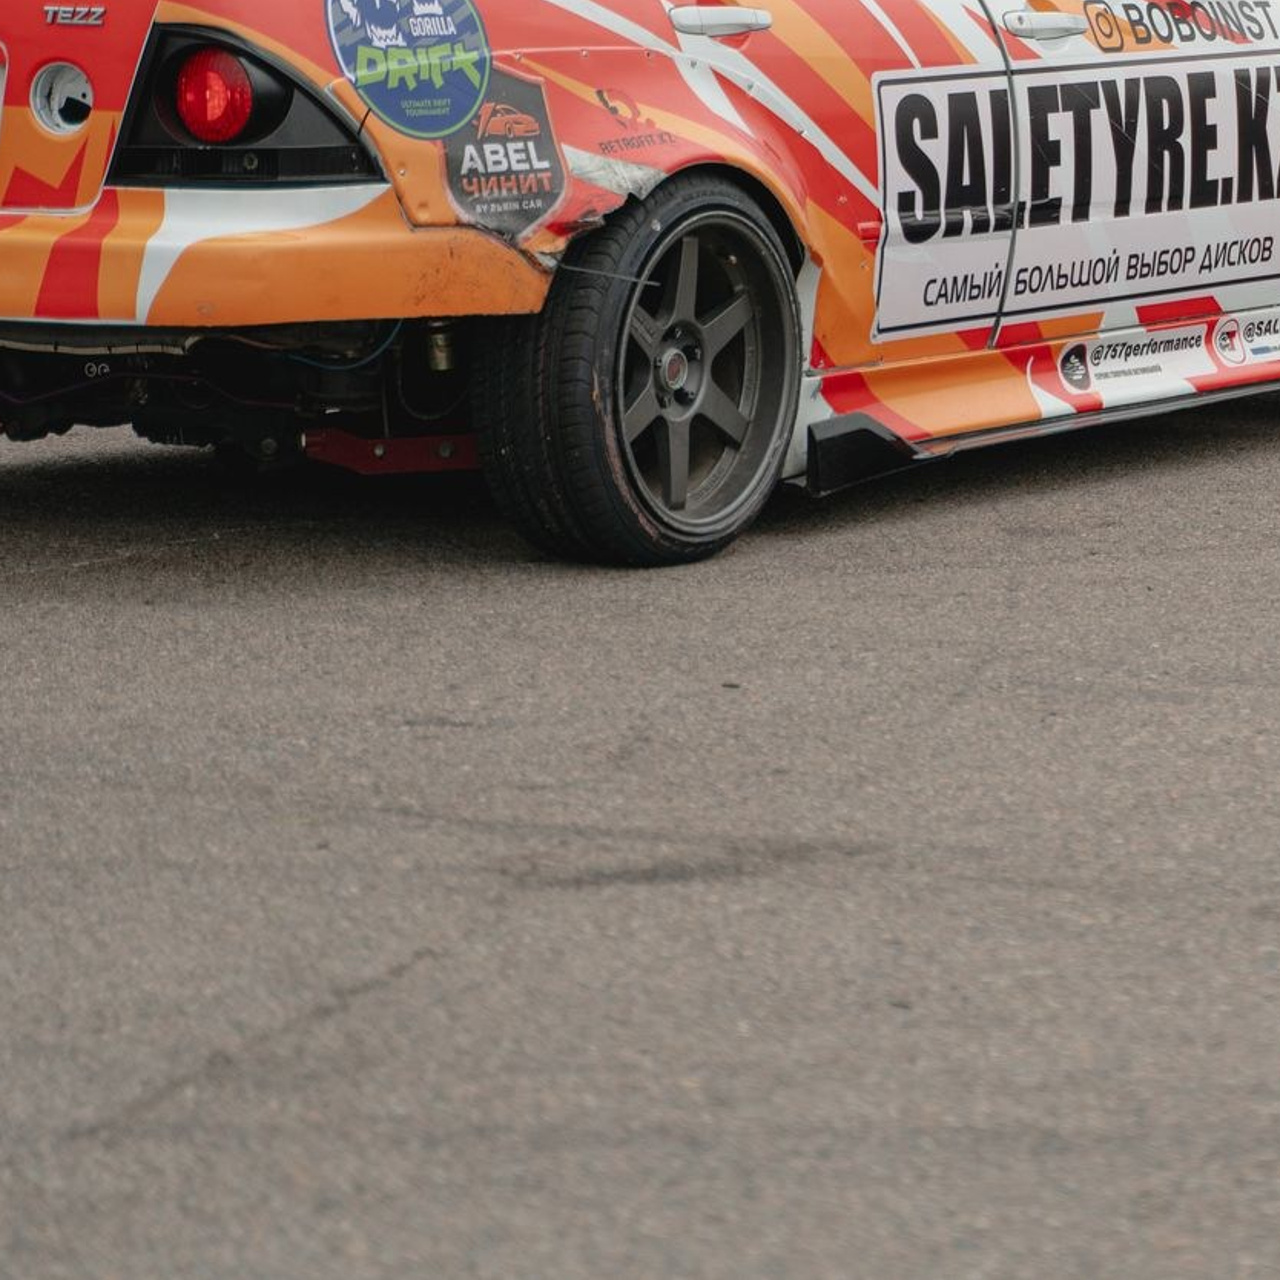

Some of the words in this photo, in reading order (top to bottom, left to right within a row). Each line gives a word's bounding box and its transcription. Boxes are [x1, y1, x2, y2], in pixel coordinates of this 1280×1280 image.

[43, 5, 106, 25] TEZZ
[409, 15, 456, 37] GORILLA
[1122, 0, 1279, 44] BOBOINST
[357, 42, 481, 91] DRIFT
[461, 141, 550, 175] ABEL
[462, 173, 552, 197] ЧИНИТ
[522, 199, 543, 211] CAR
[923, 261, 1002, 307] САМЫЙ
[1014, 248, 1120, 296] БОЛЬШОЙ
[1126, 246, 1195, 279] ВЫБОР
[1199, 236, 1274, 274] ДИСКОВ
[1090, 334, 1202, 367] @757performance
